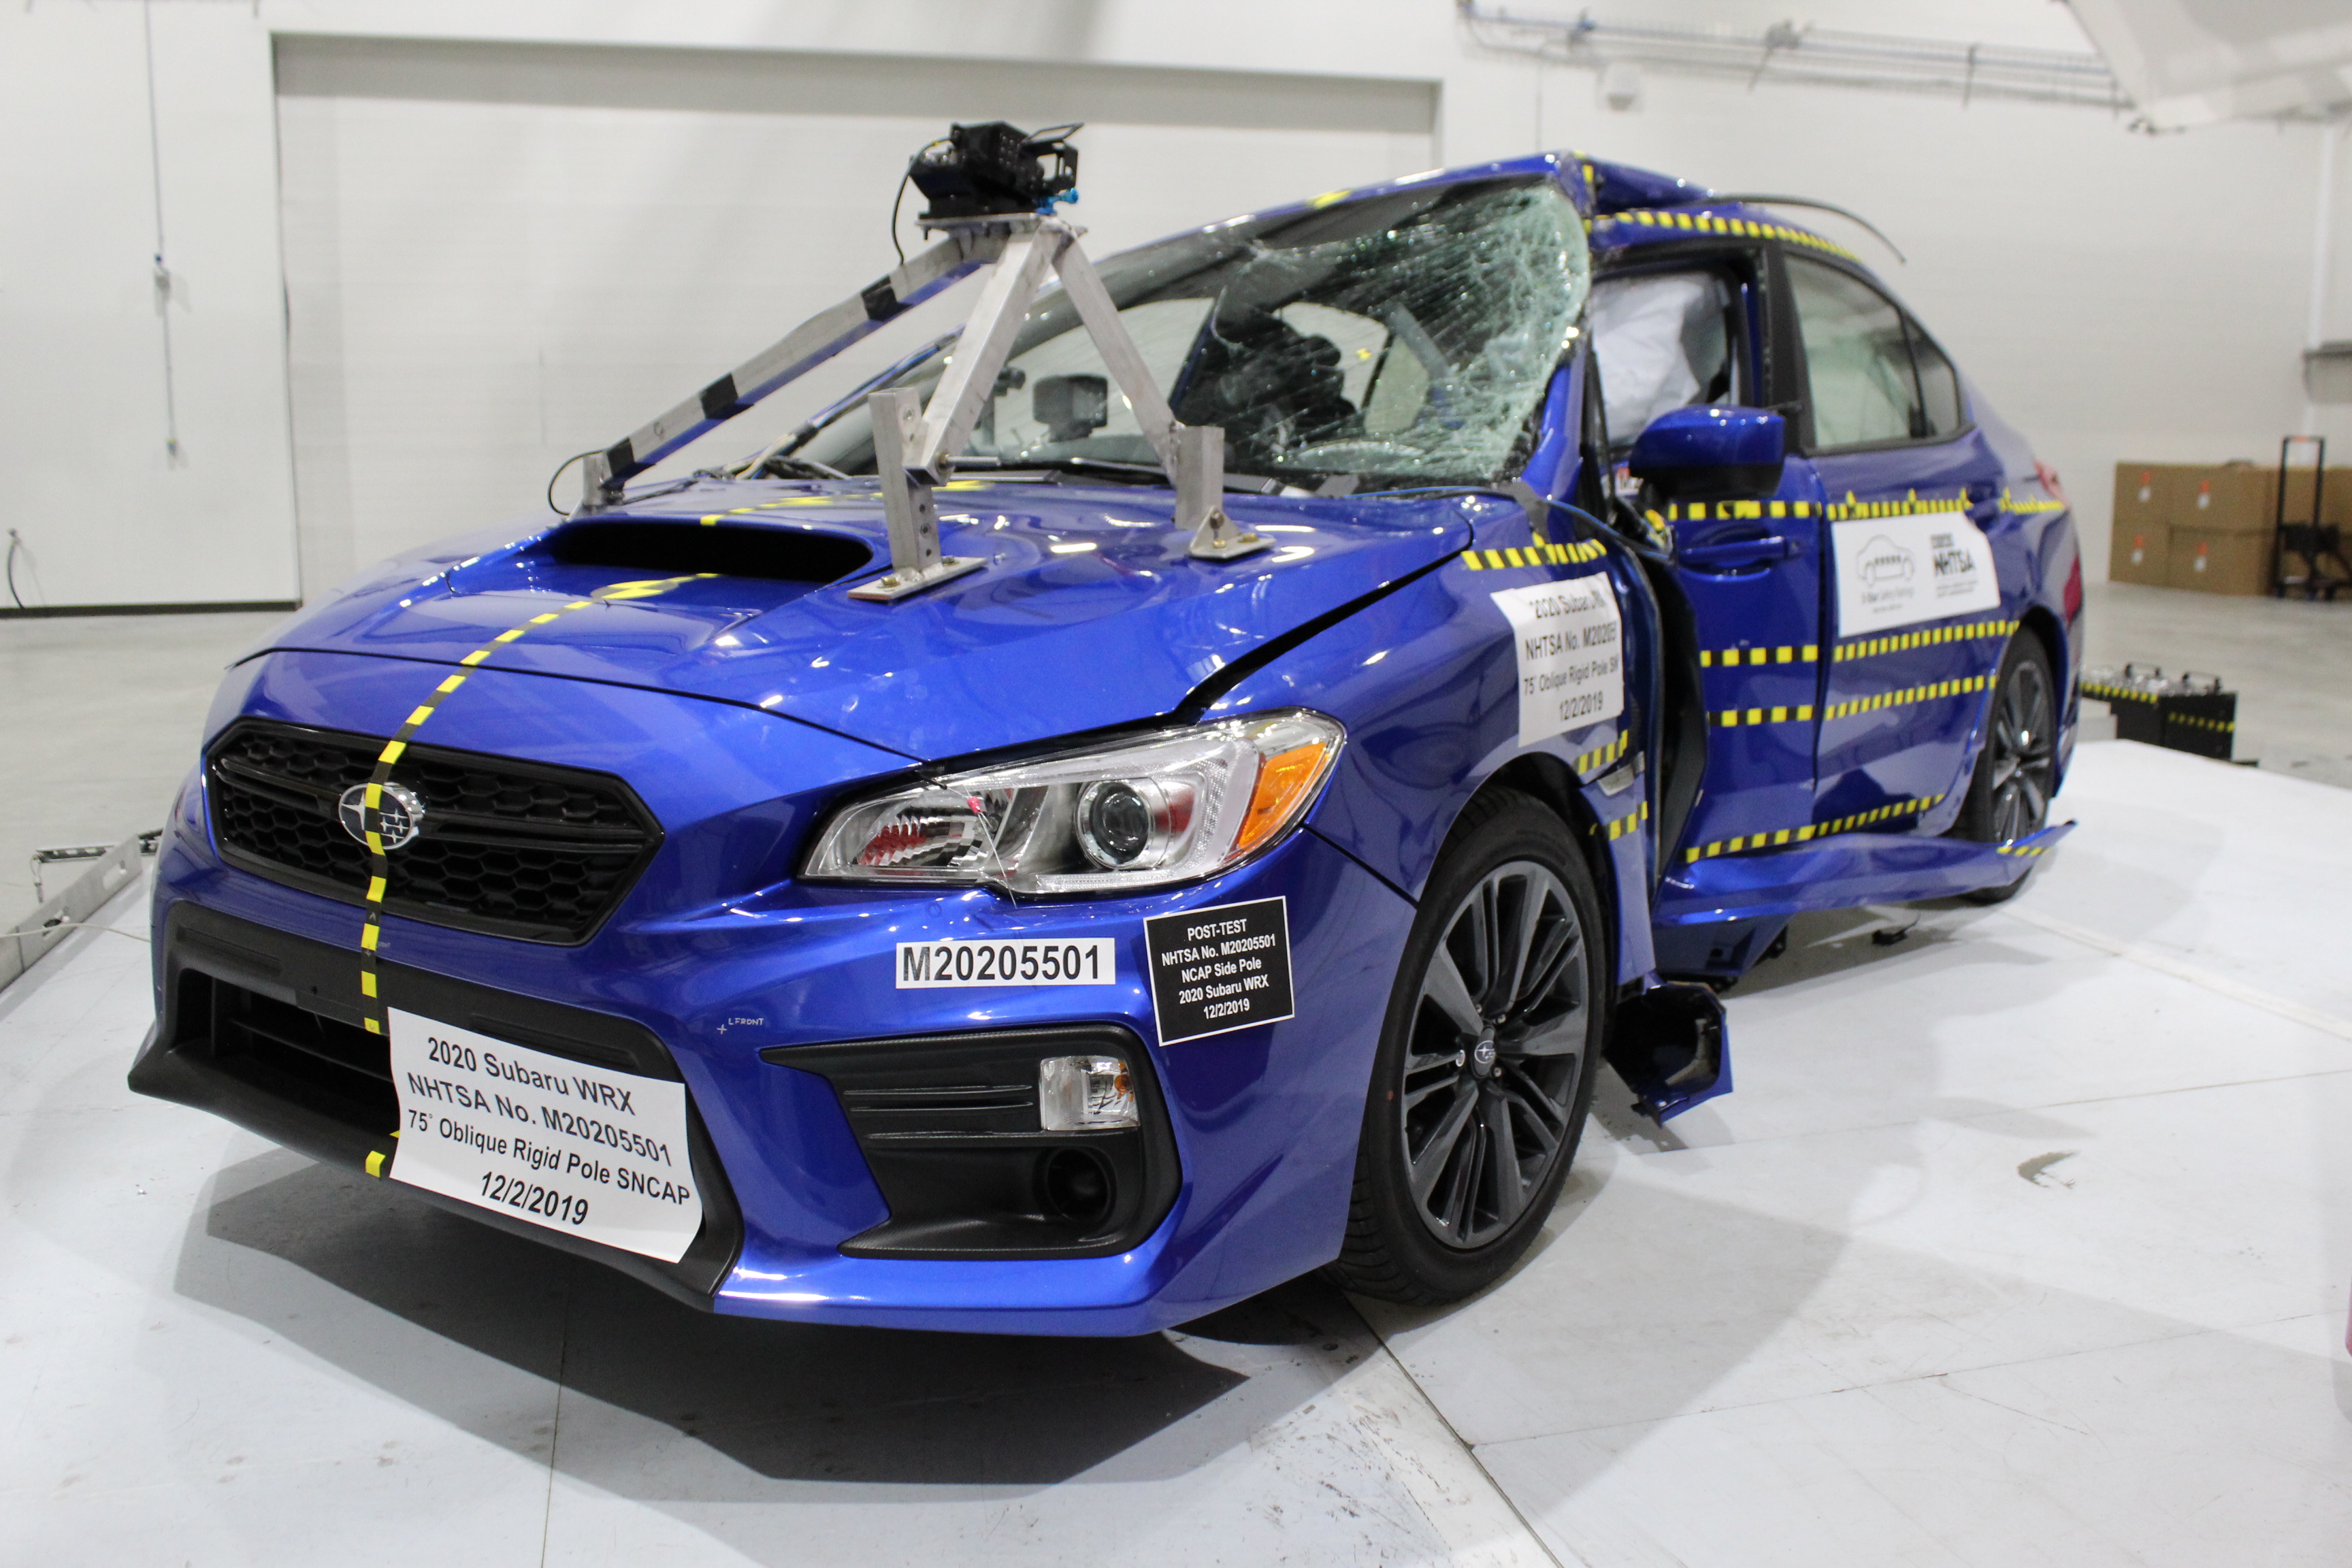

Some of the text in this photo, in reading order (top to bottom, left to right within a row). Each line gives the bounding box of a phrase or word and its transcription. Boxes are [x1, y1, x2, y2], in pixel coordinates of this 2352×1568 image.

[1524, 632, 1564, 661] NHTSA
[1188, 919, 1247, 941] POST-TEST
[903, 945, 1098, 981] M20205501
[1161, 934, 1276, 966] NHTSA No. M20205501
[1181, 957, 1262, 983] NCAP Side Pole
[1179, 974, 1269, 1004] 2020 Subaru WRX
[728, 1017, 764, 1026] L FRONT
[1204, 998, 1250, 1019] 12/2/2019
[428, 1036, 636, 1115] 2020 Subaru WRX
[408, 1072, 672, 1167] NHTSA No. M20205501
[440, 1117, 507, 1155] Oblique
[513, 1138, 559, 1170] Rigid
[567, 1156, 610, 1184] Pole
[617, 1167, 690, 1205] SNCAP
[481, 1171, 589, 1225] 12/2/2019
